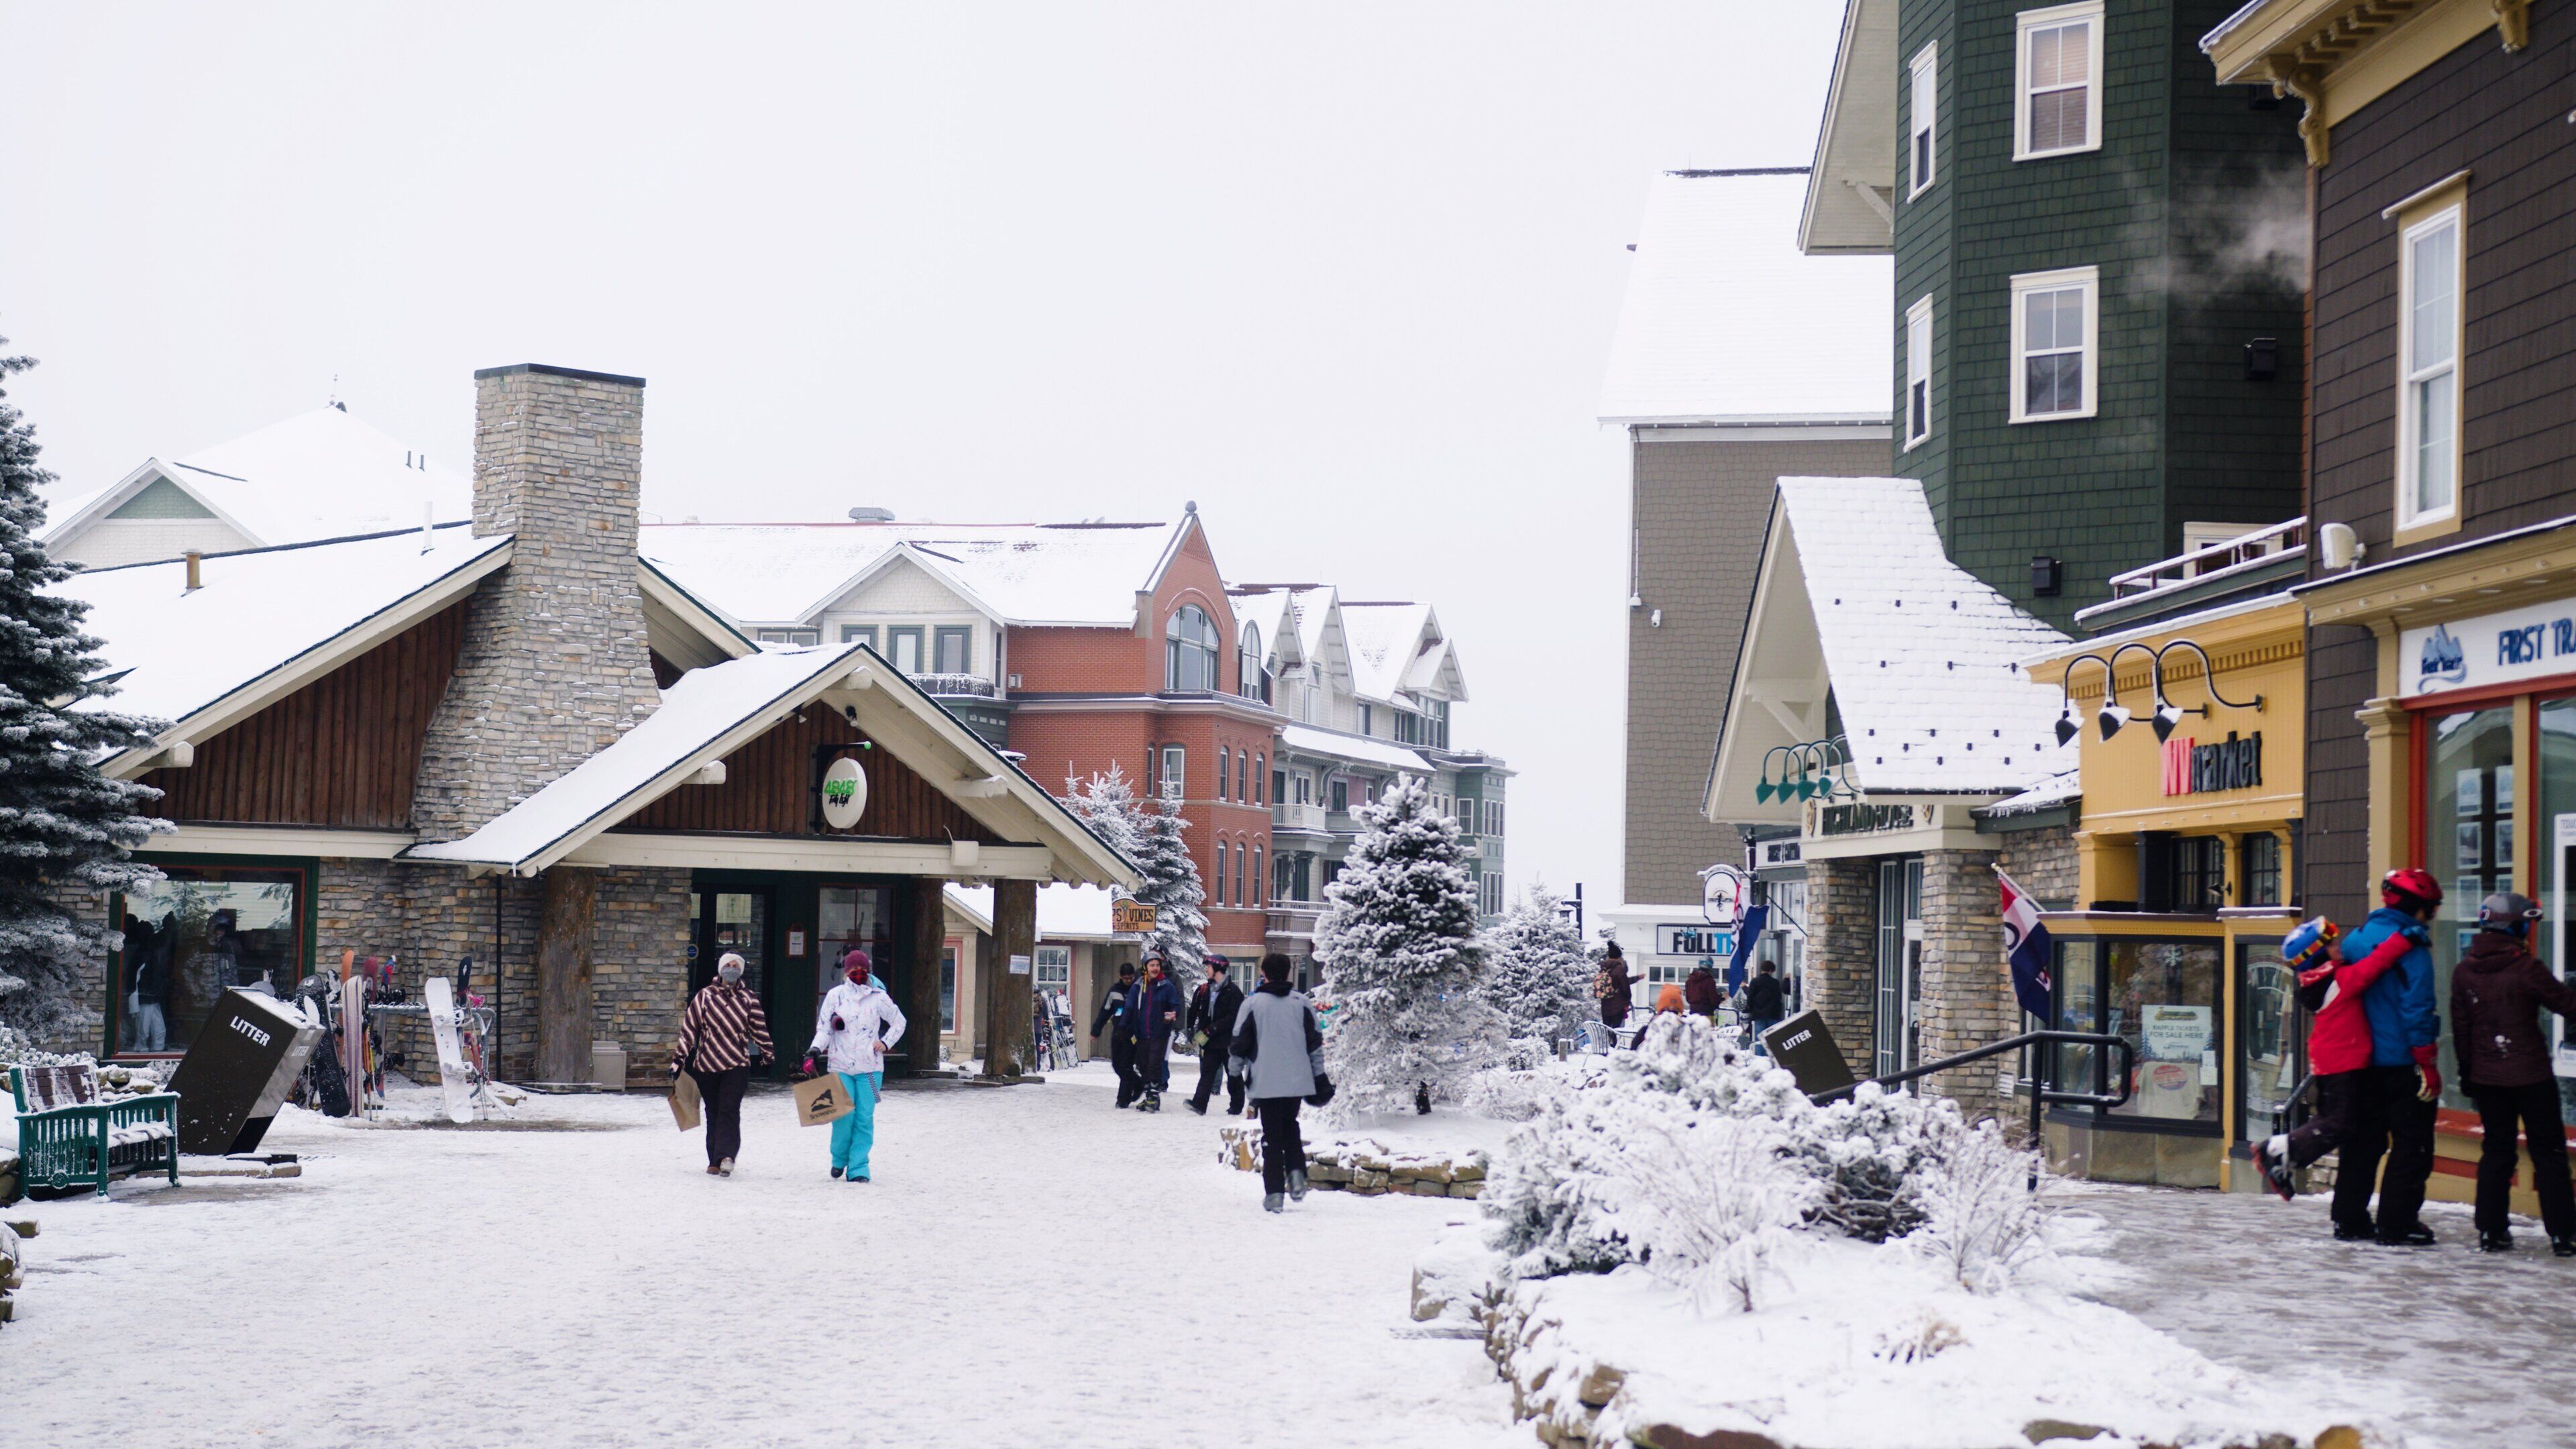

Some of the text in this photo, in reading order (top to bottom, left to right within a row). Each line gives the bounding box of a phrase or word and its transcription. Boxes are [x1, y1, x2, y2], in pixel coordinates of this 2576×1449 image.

[2498, 624, 2545, 665] FIRST
[1129, 908, 1154, 922] VINES
[229, 1016, 271, 1046] LITTER
[1782, 1029, 1812, 1051] LITTER
[291, 1045, 309, 1057] LITTER
